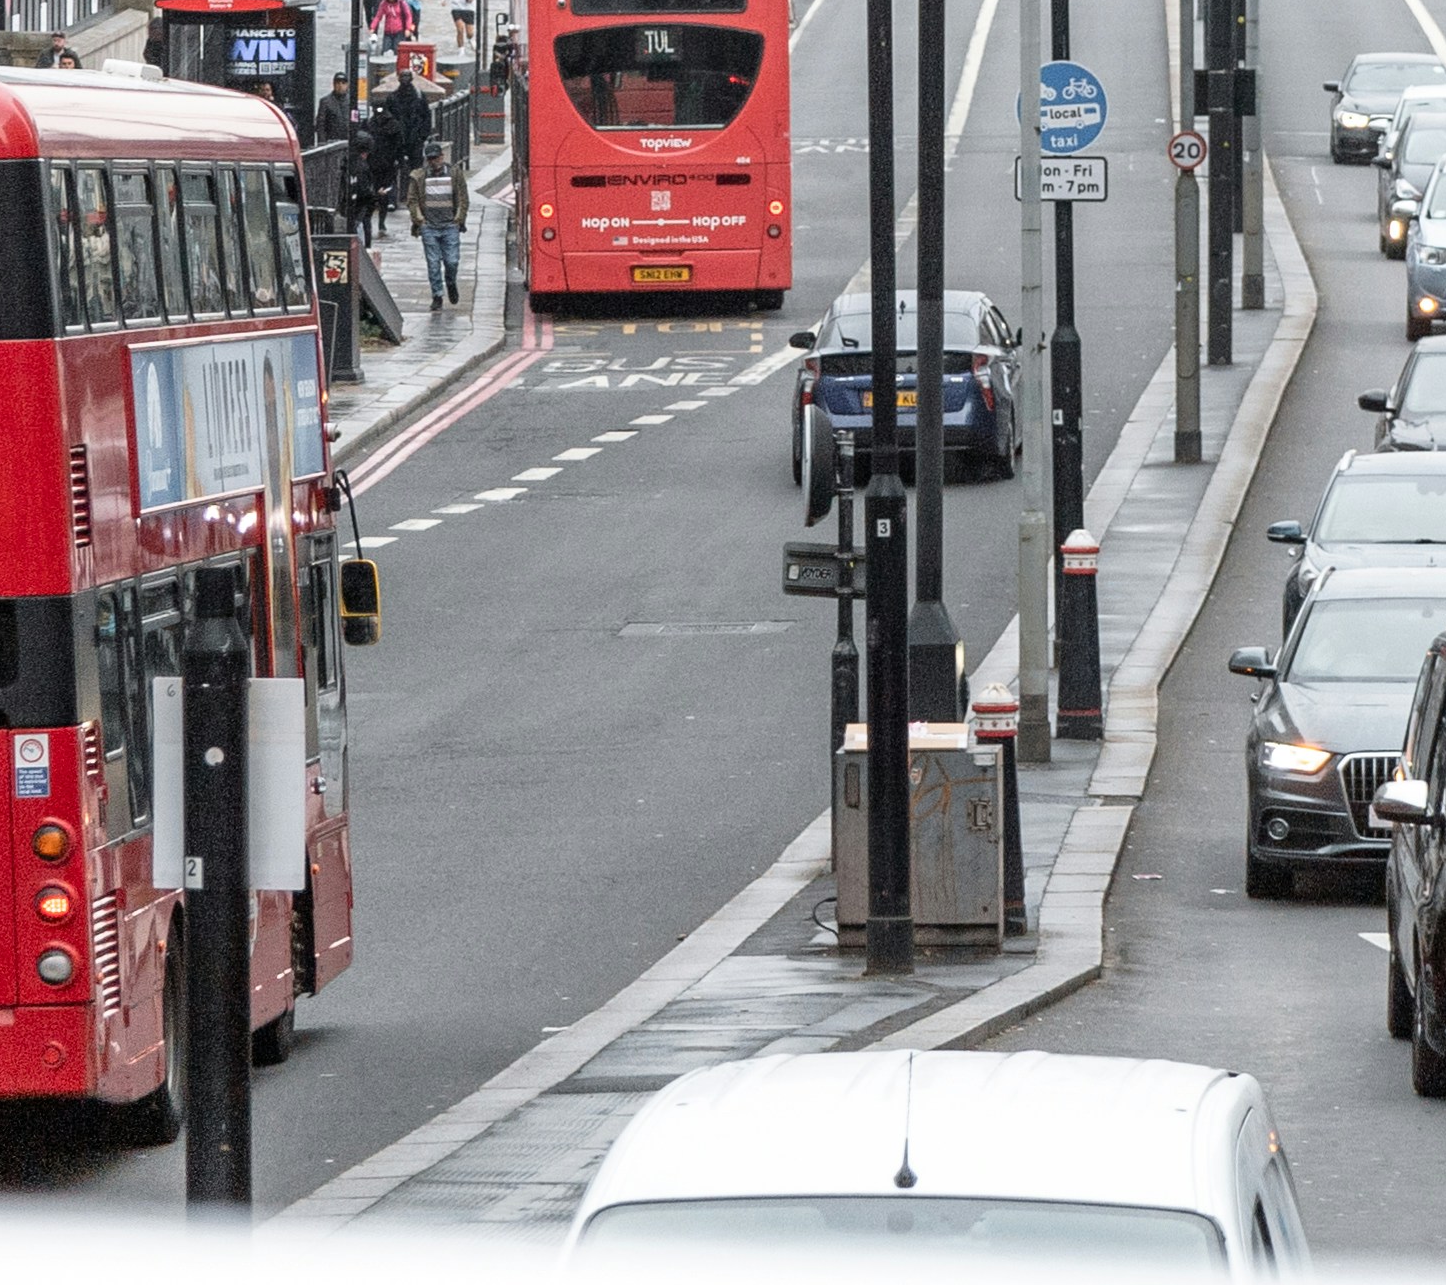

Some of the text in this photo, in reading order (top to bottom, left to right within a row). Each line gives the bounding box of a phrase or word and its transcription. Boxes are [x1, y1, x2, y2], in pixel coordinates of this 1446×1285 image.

[235, 28, 296, 38] HANCE TO
[644, 30, 675, 53] TVL
[1050, 107, 1082, 120] local
[1050, 134, 1078, 148] taxi
[1040, 166, 1061, 177] on
[1073, 164, 1092, 177] Fri
[632, 236, 670, 246] Designed
[692, 235, 709, 244] USA
[542, 356, 736, 373] BUS
[879, 521, 888, 534] 3
[166, 683, 176, 698] 6
[187, 858, 197, 877] 2
